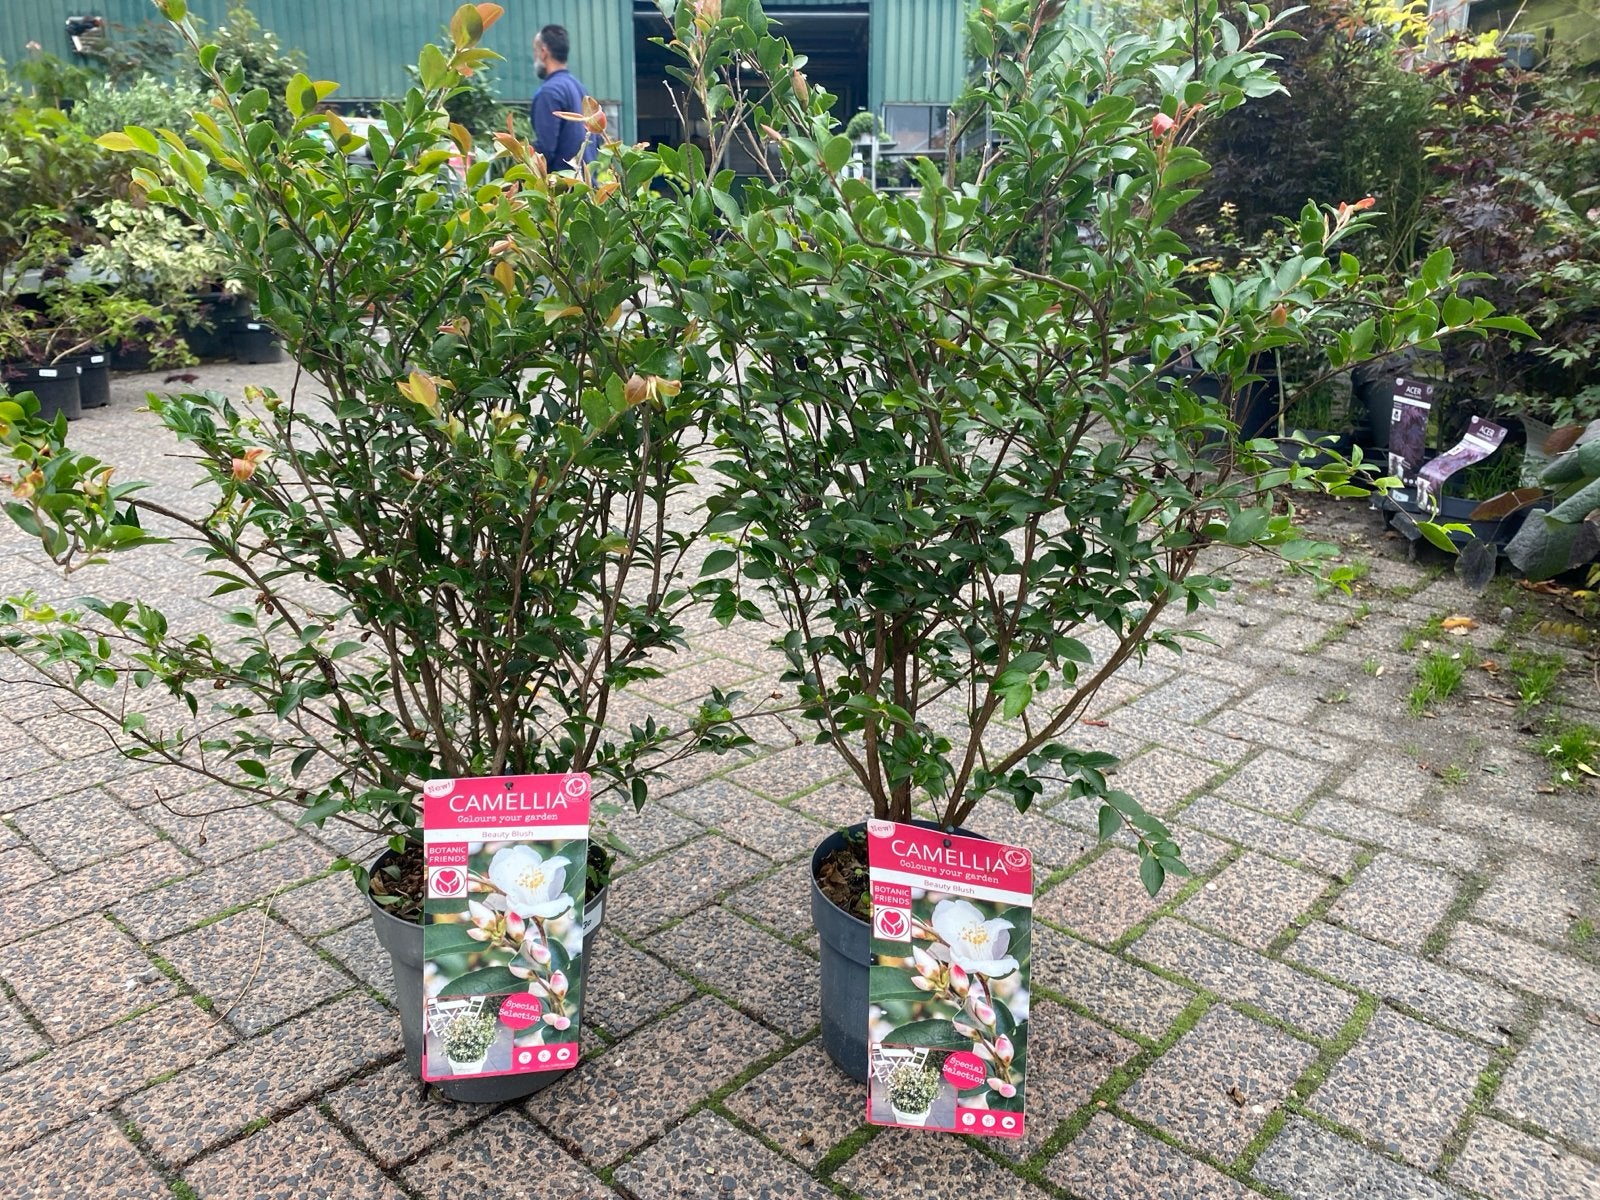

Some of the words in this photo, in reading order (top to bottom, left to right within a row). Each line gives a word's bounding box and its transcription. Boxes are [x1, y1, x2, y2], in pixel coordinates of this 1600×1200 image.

[1405, 386, 1422, 395] ACER
[1479, 425, 1495, 436] ACER
[428, 780, 454, 793] New!
[449, 791, 568, 812] CAMELLIA
[457, 815, 497, 823] Colours
[499, 814, 522, 823] your
[524, 813, 558, 822] garden
[870, 823, 893, 833] New!
[482, 831, 510, 839] Beauty
[511, 830, 534, 838] Blush
[429, 846, 466, 854] BOTANIC
[891, 839, 1009, 875] CAMELLIA
[899, 859, 937, 873] Colours
[939, 867, 963, 878] your
[965, 872, 999, 884] garden
[874, 885, 910, 896] BOTANIC
[924, 880, 951, 890] Beauty
[953, 884, 975, 895] Blush
[874, 894, 910, 905] FRIENDS
[506, 1000, 539, 1012] Special
[498, 1008, 541, 1022] Selection
[948, 1057, 984, 1075] Special
[942, 1065, 986, 1085] Selection
